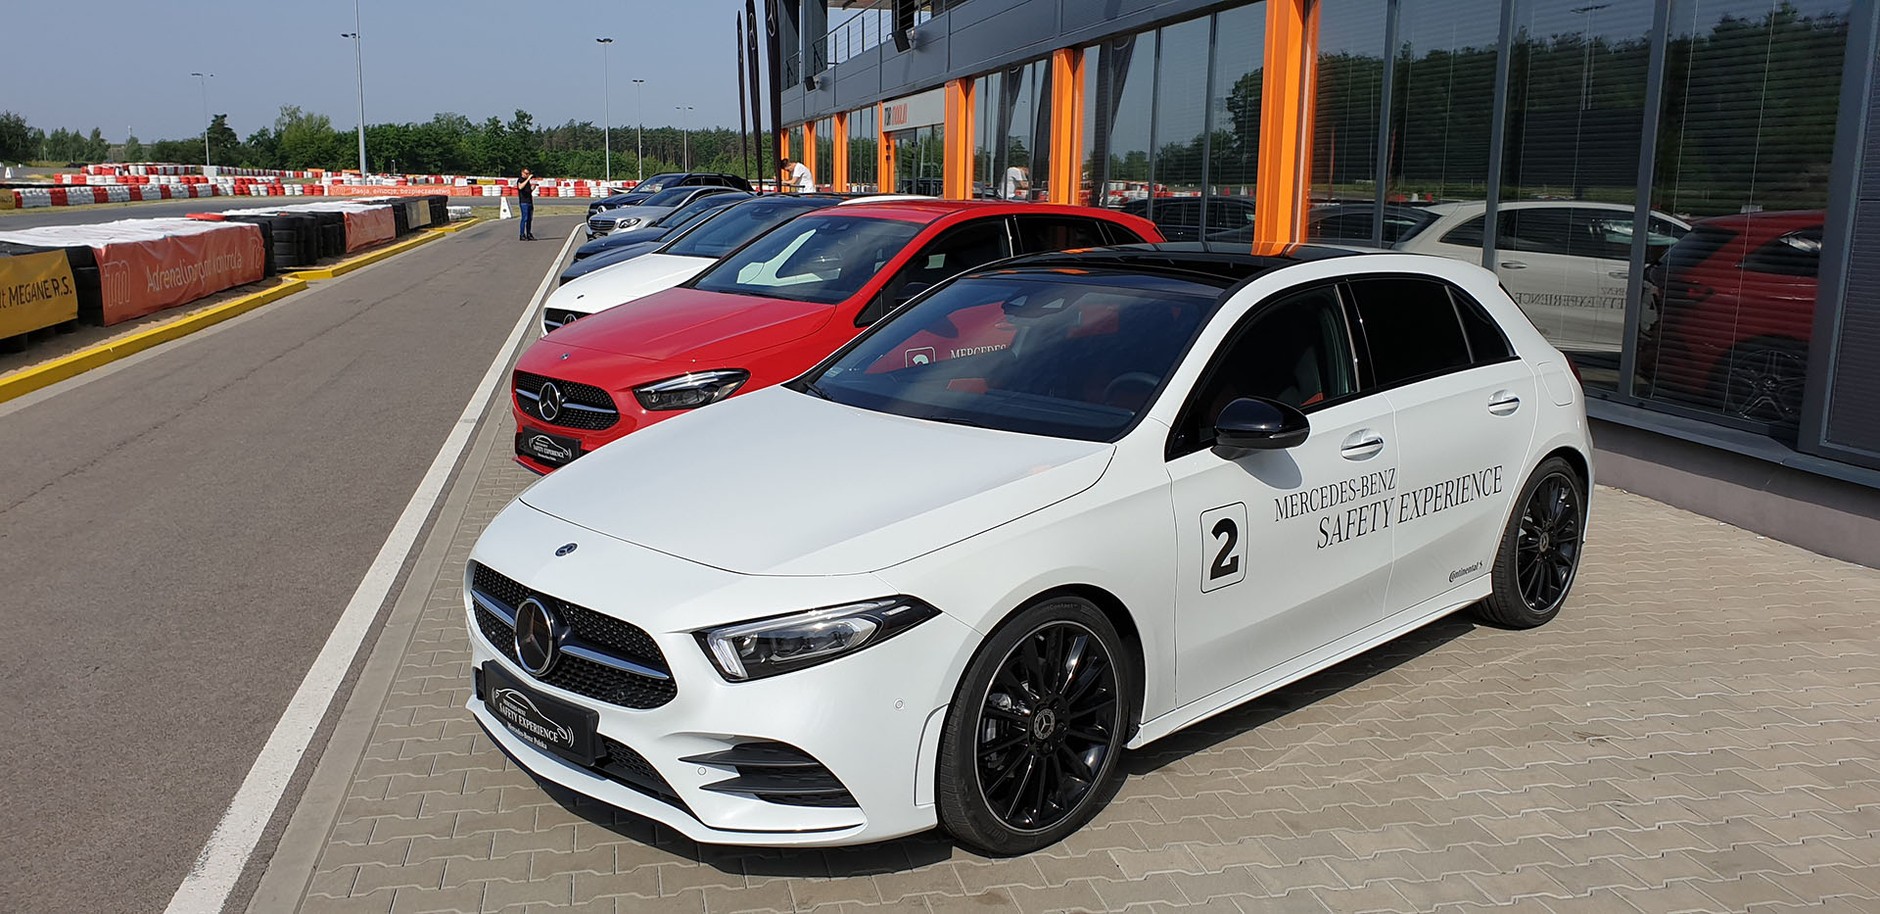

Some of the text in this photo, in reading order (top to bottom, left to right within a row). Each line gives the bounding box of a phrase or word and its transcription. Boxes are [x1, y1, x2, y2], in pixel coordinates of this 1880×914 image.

[52, 276, 73, 297] R.S.
[1274, 467, 1396, 522] MERCEDES-BENZ
[1316, 465, 1503, 550] SAFETY EXPERIENCE
[1210, 517, 1240, 580] 2
[499, 702, 558, 743] SAFETY EXPERIENCE
